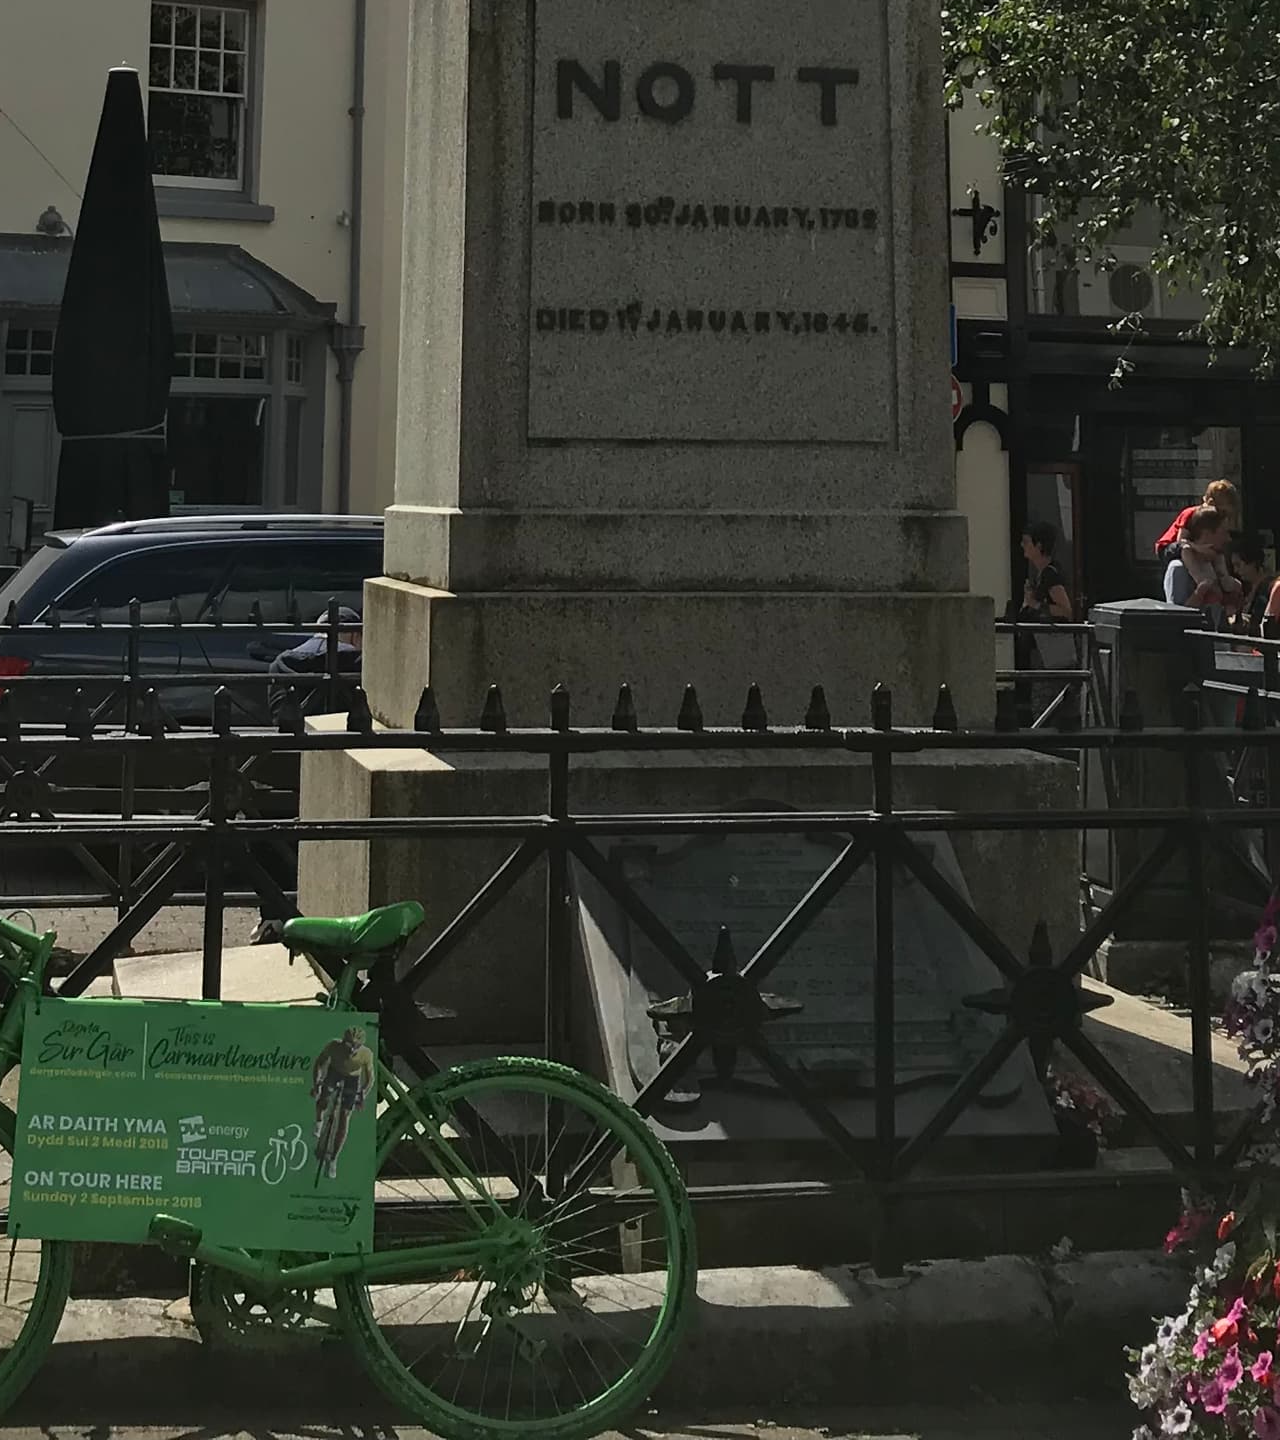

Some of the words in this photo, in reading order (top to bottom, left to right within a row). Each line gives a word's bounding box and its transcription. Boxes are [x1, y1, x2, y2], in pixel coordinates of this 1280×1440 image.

[556, 58, 860, 127] NOTT
[538, 200, 616, 225] BORN
[536, 307, 609, 332] DIED
[168, 1023, 200, 1047] This
[203, 1032, 217, 1046] is
[38, 1030, 84, 1064] Sir
[148, 1038, 312, 1072] Carmarthenshire
[27, 1114, 55, 1131] AR
[59, 1115, 119, 1133] DAITH
[123, 1117, 167, 1135] YMA
[208, 1125, 250, 1140] energy
[27, 1133, 64, 1149] Dydd
[67, 1135, 89, 1147] Sul
[91, 1135, 101, 1148] 2
[102, 1136, 137, 1149] Medi
[138, 1137, 169, 1150] 2018
[176, 1147, 229, 1161] TOUR
[230, 1149, 257, 1162] OF
[175, 1160, 256, 1177] BRITAIN
[24, 1170, 54, 1187] ON
[58, 1171, 111, 1189] TOUR
[115, 1173, 163, 1191] HERE
[23, 1190, 77, 1206] Sunday
[79, 1192, 89, 1204] 2
[91, 1193, 169, 1209] September
[171, 1195, 202, 1208] 2018
